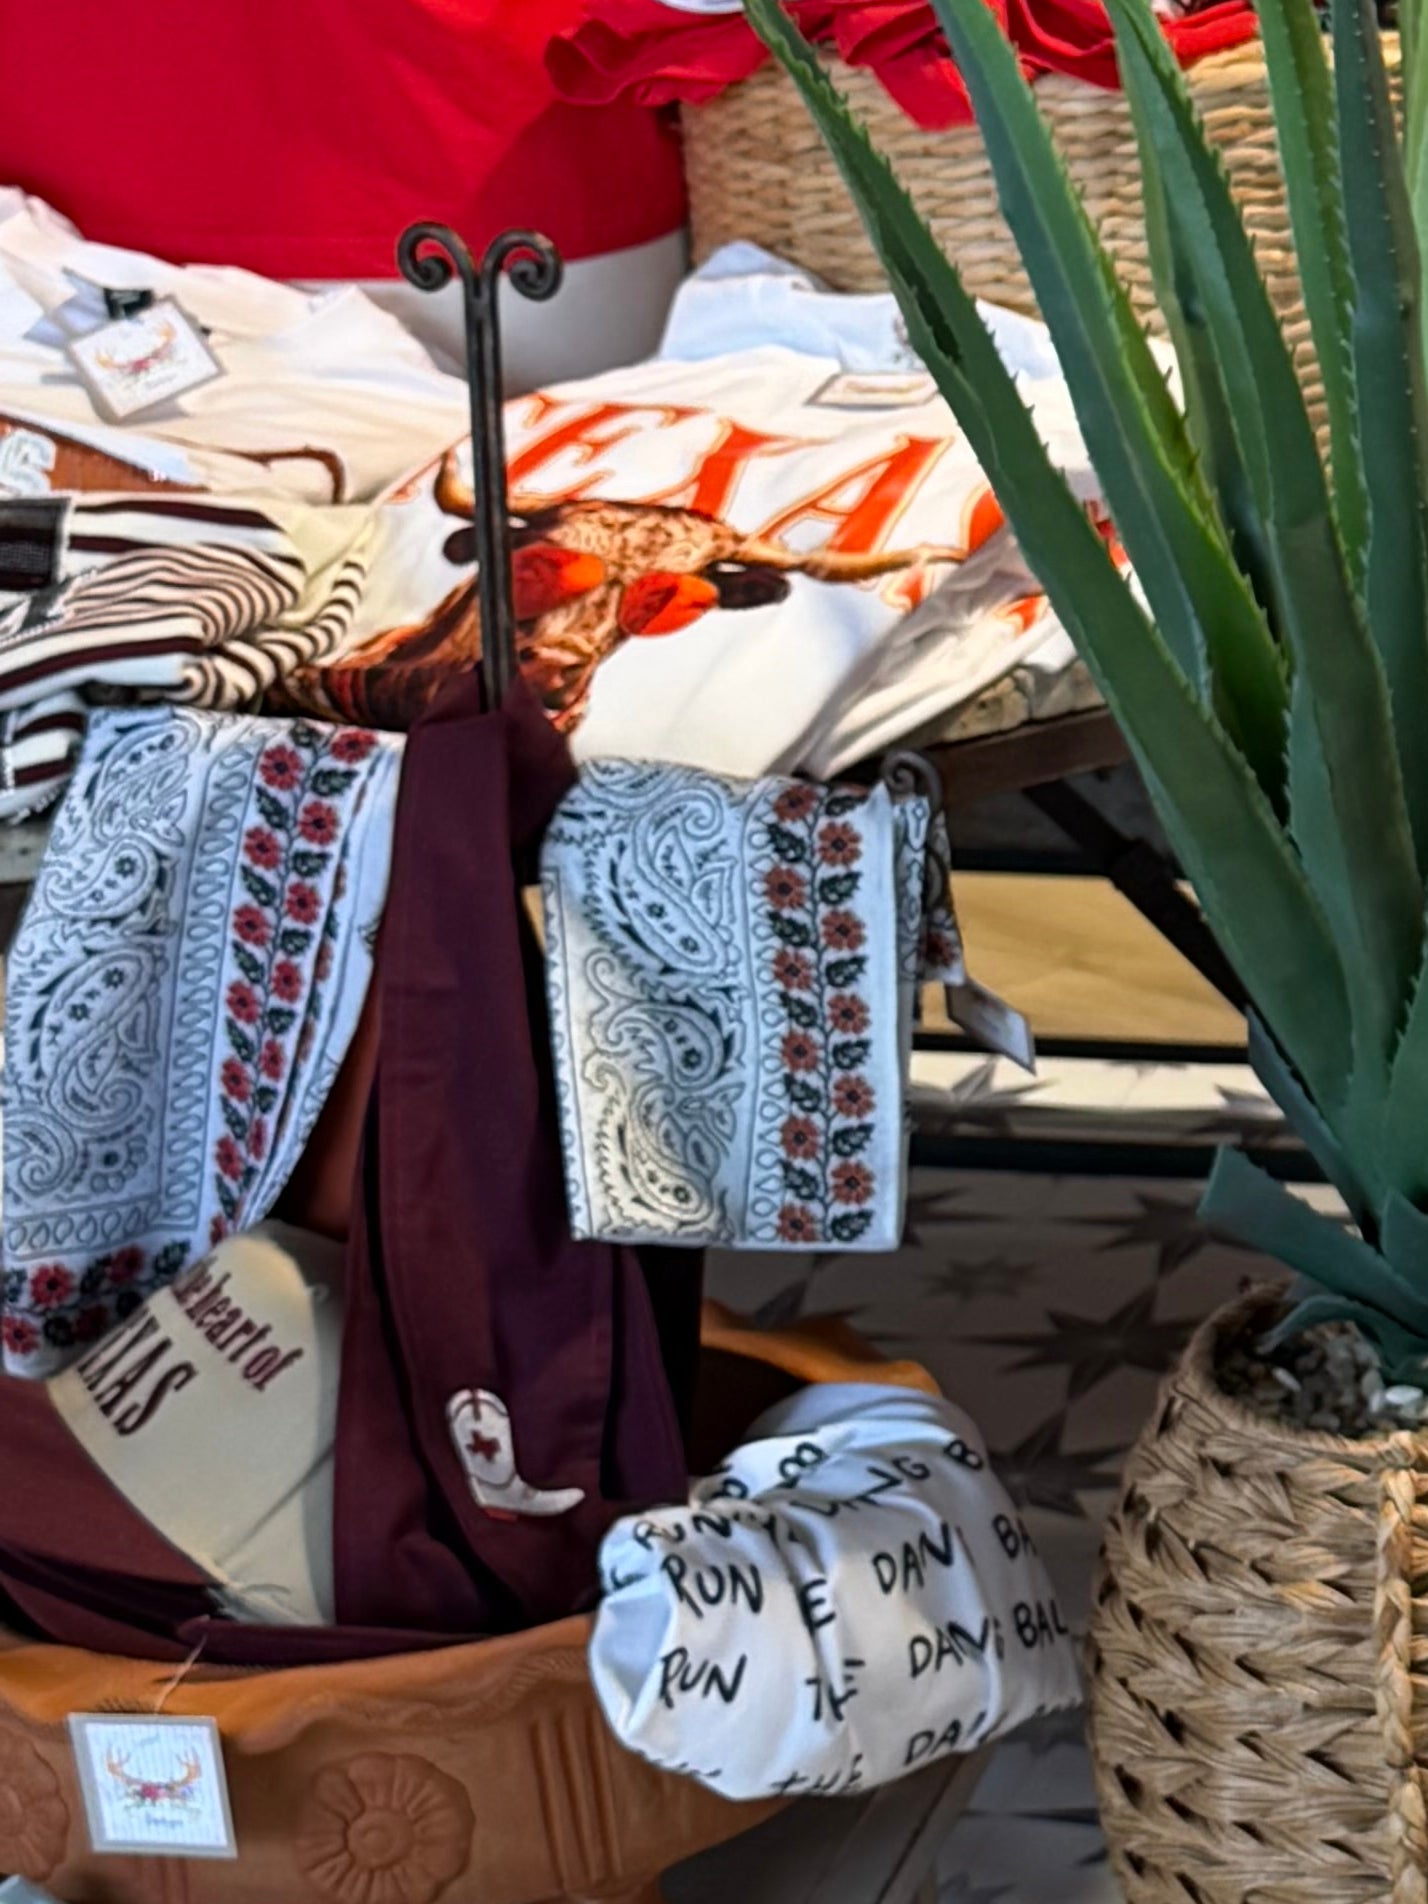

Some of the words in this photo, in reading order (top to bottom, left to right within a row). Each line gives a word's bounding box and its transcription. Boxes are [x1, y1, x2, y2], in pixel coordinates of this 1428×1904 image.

[184, 1271, 273, 1364] heart
[242, 1346, 304, 1393] of
[661, 1553, 764, 1619] RUN
[660, 1647, 747, 1709] RUN
